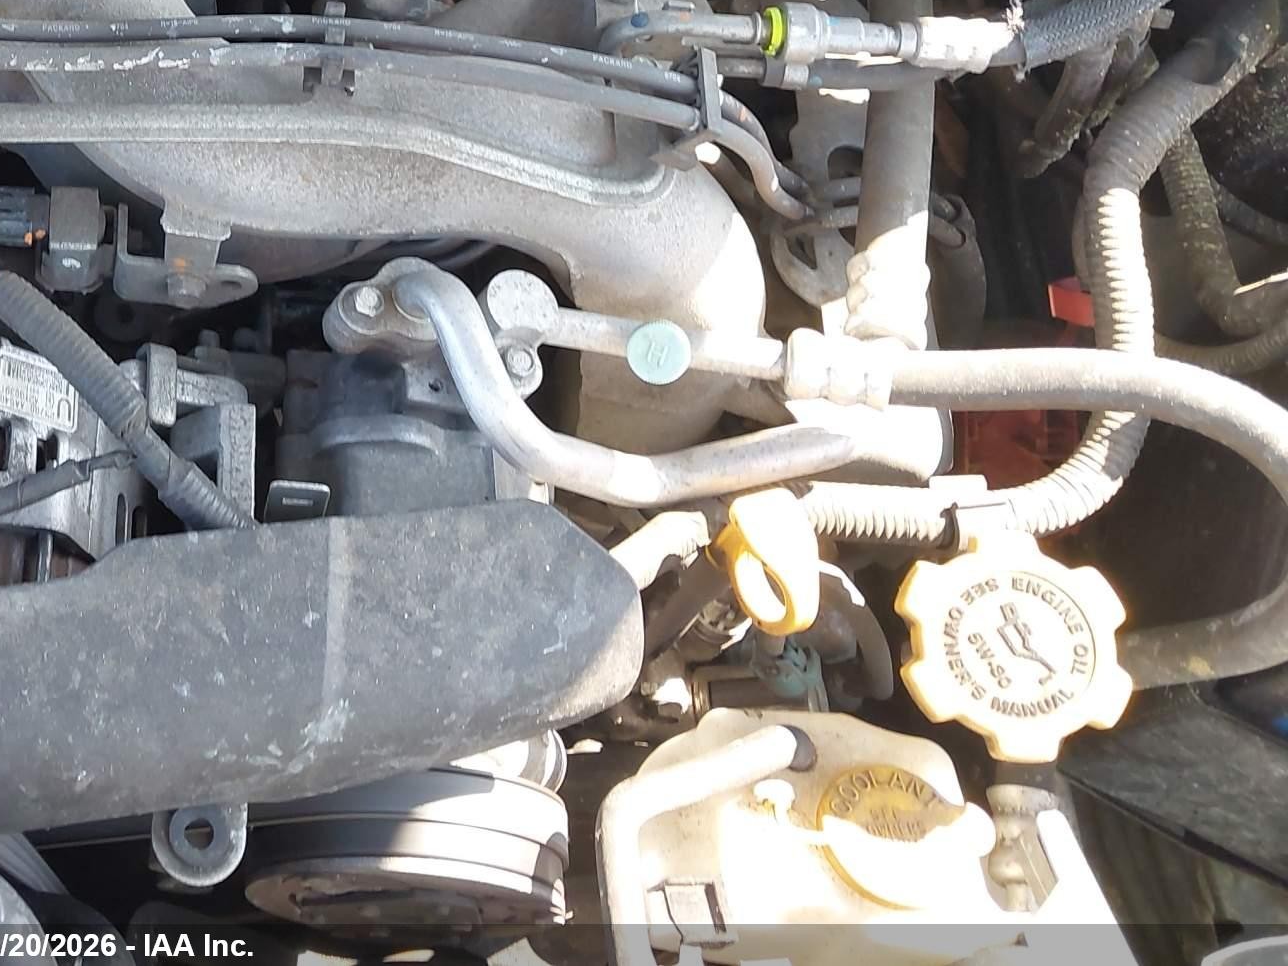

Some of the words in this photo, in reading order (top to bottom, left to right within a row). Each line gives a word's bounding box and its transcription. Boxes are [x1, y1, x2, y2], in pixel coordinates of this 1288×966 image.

[959, 577, 1000, 606] SEE
[989, 688, 1076, 719] MANUAL
[1010, 575, 1085, 636] ENGINE
[1069, 642, 1090, 676] OIL
